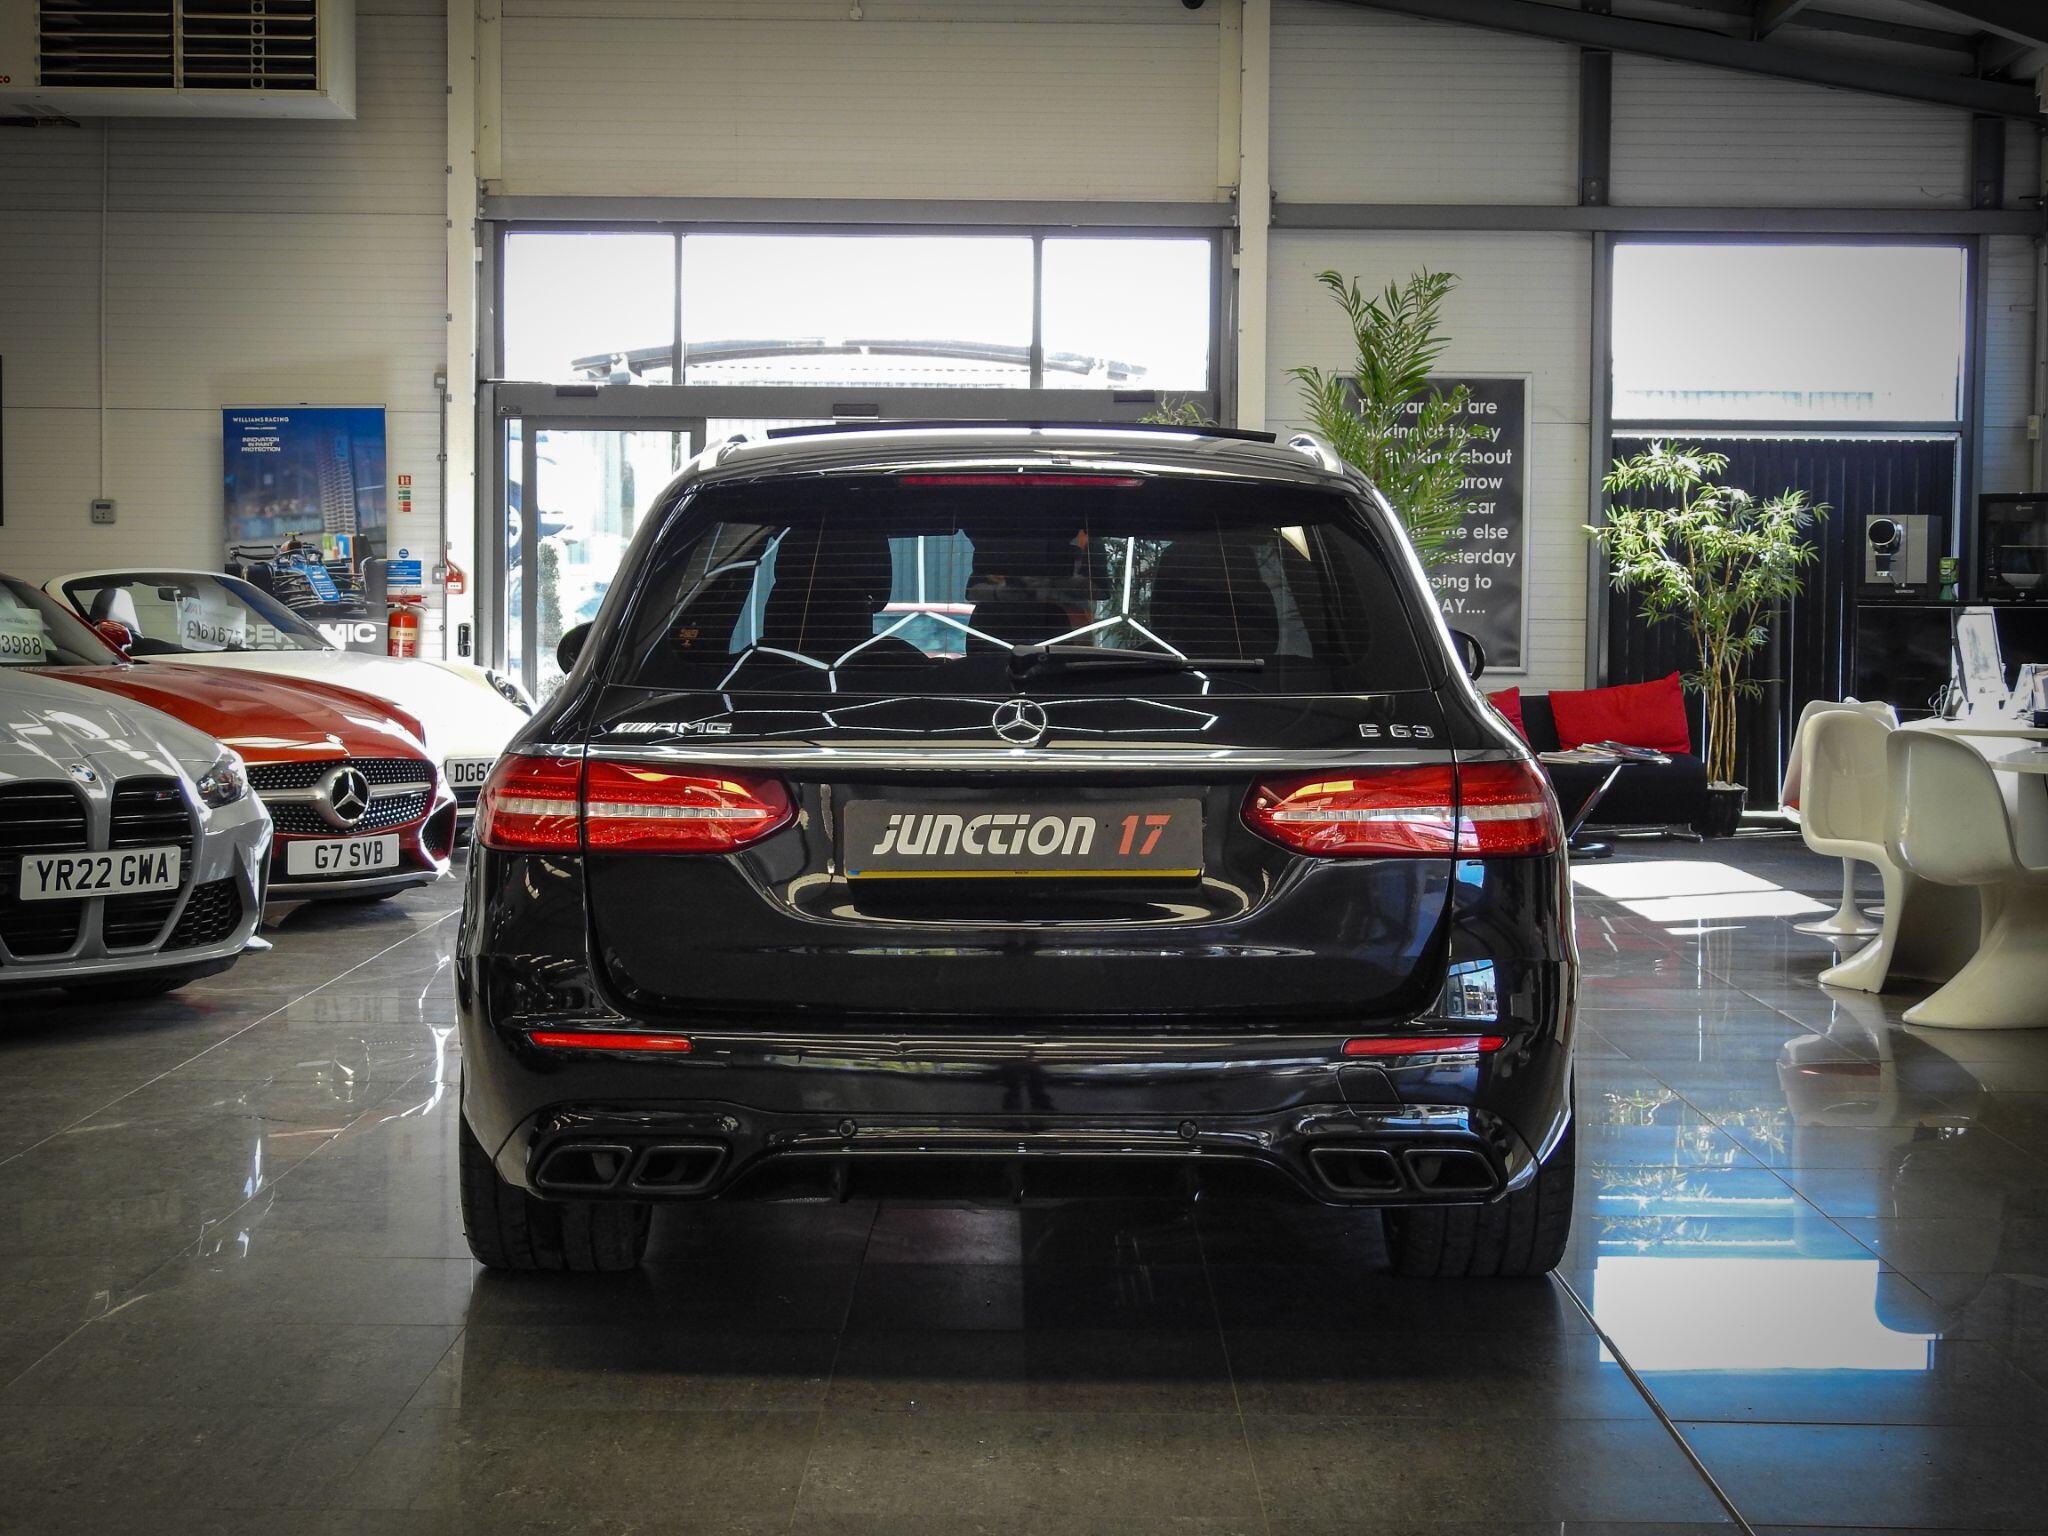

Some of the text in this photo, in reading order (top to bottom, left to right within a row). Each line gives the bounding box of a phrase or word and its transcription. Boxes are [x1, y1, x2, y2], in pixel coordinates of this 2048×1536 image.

[1468, 402, 1498, 414] are
[1460, 449, 1513, 465] about
[1466, 502, 1496, 514] car
[1473, 523, 1509, 539] else
[1427, 573, 1492, 593] oing to
[650, 722, 733, 734] AMG
[1358, 723, 1435, 739] E 63
[1117, 814, 1172, 856] 17
[314, 840, 383, 869] G7 SVB
[36, 852, 169, 892] YR22 GWA
